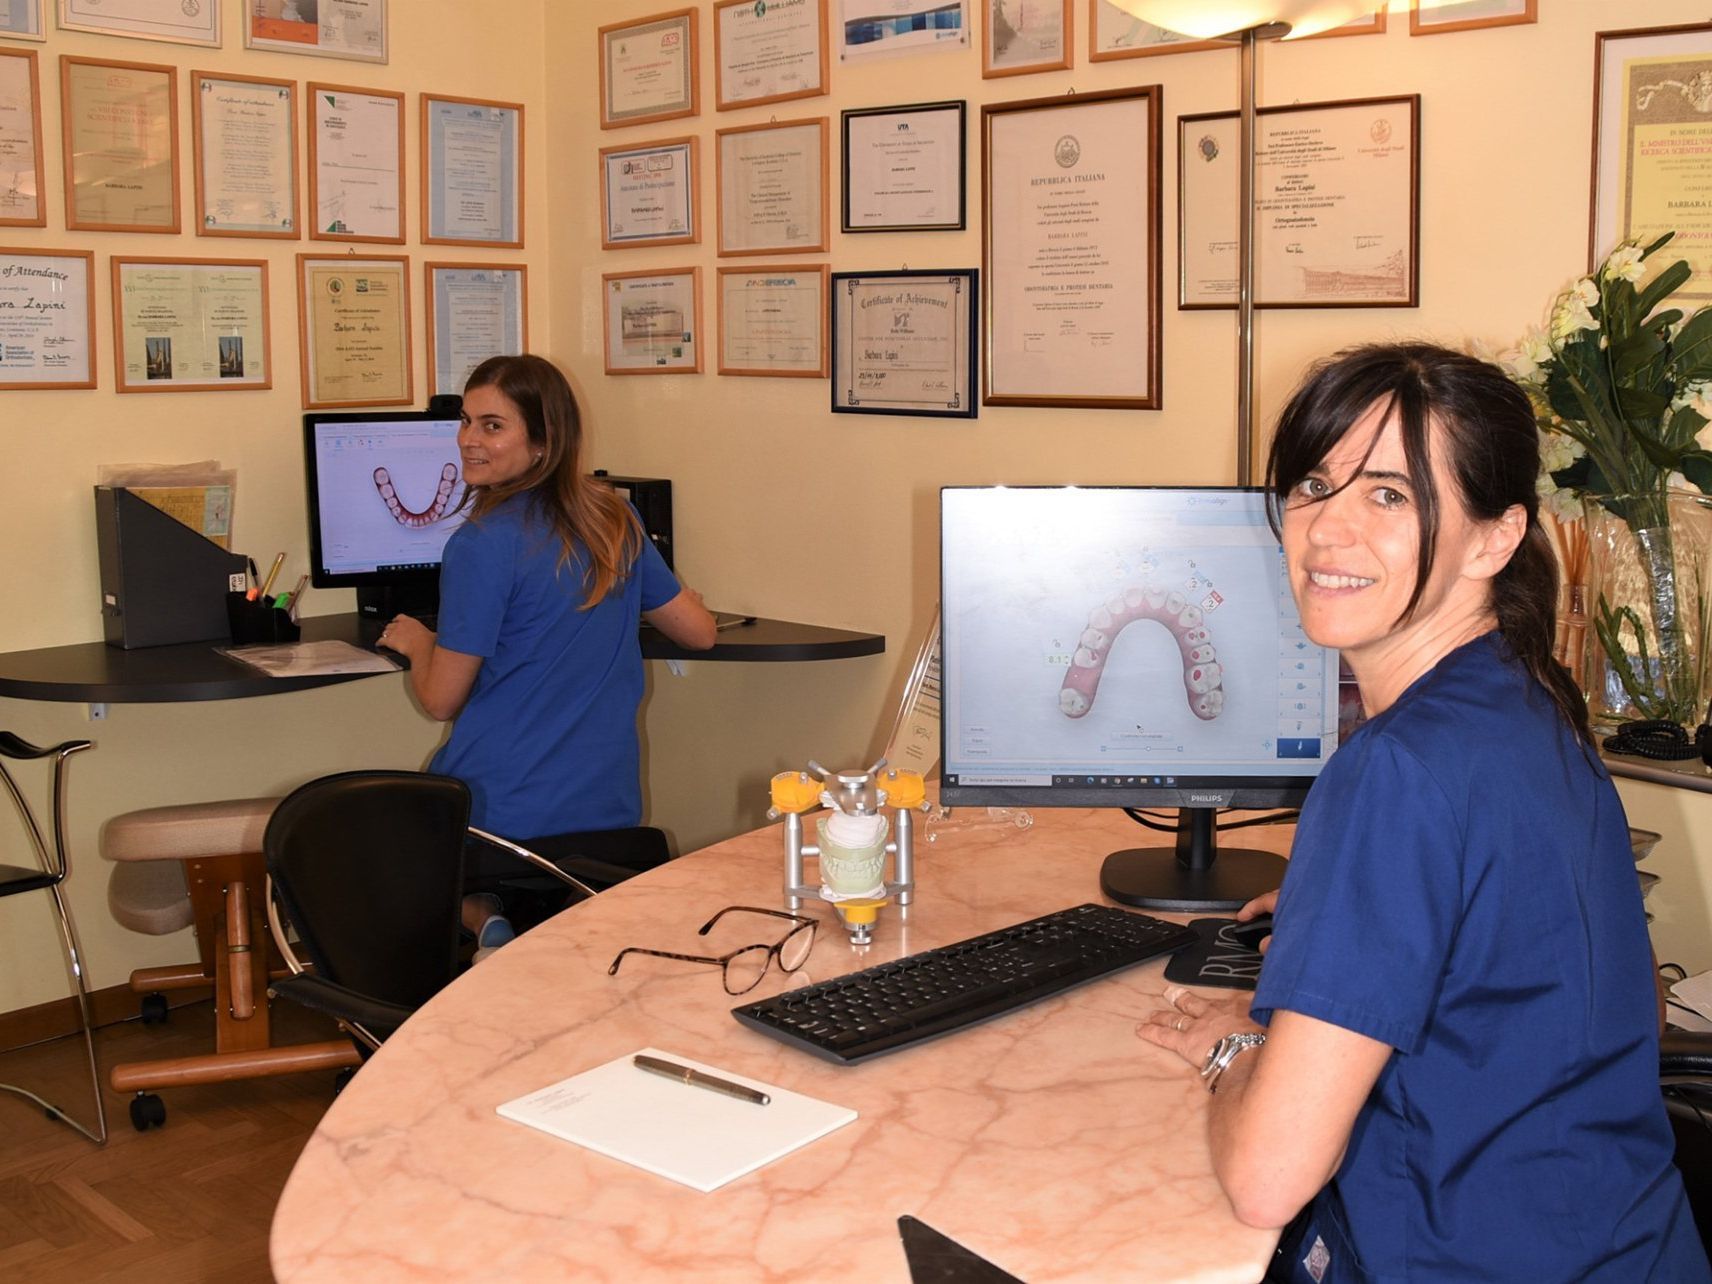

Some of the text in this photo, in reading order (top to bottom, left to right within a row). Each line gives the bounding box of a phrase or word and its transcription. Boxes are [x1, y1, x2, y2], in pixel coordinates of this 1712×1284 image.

[897, 123, 909, 131] UTA
[1030, 173, 1105, 186] REPUBBLICA ITALIANA
[1667, 201, 1706, 209] BARBARA
[2, 264, 69, 281] of Attendance
[24, 297, 66, 313] Lapini
[861, 293, 948, 309] Certificate of Achievement
[1191, 794, 1223, 802] PHILIPS
